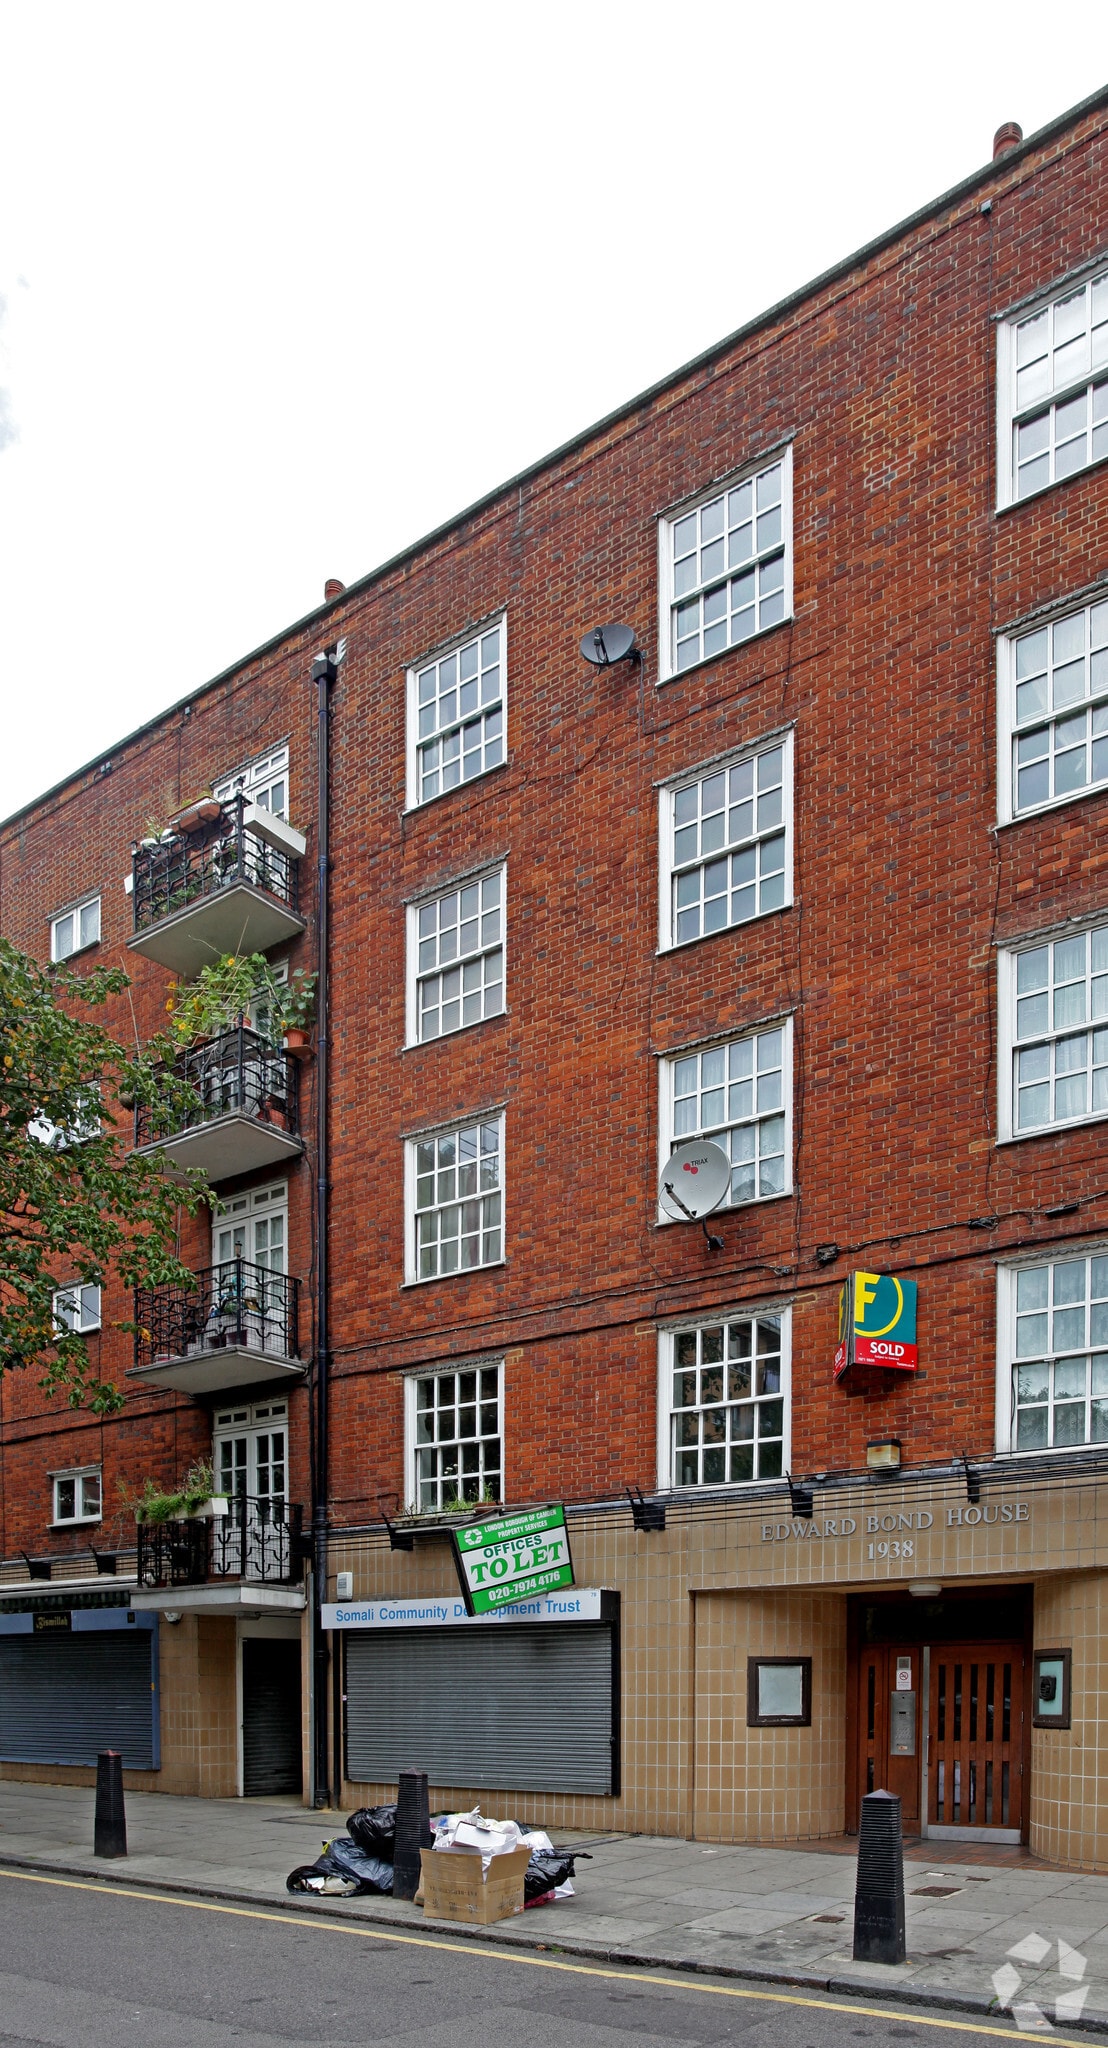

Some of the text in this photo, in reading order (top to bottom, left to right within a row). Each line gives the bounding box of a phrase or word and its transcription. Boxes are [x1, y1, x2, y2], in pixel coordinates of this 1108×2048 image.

[691, 1158, 708, 1166] TRIAX
[869, 1341, 905, 1357] SOLD
[484, 1508, 557, 1533] LONDON BOROUGH OF CAMDEN
[497, 1519, 548, 1538] PROPERTY SERVICES
[760, 1503, 1030, 1542] EDWARD BOND HOUSE
[483, 1534, 543, 1559] OFFICES
[867, 1540, 914, 1560] 1938
[470, 1540, 563, 1584] TO LET
[488, 1571, 561, 1602] 020-7974 4176
[335, 1599, 581, 1622] Somali Community Delopment Trust
